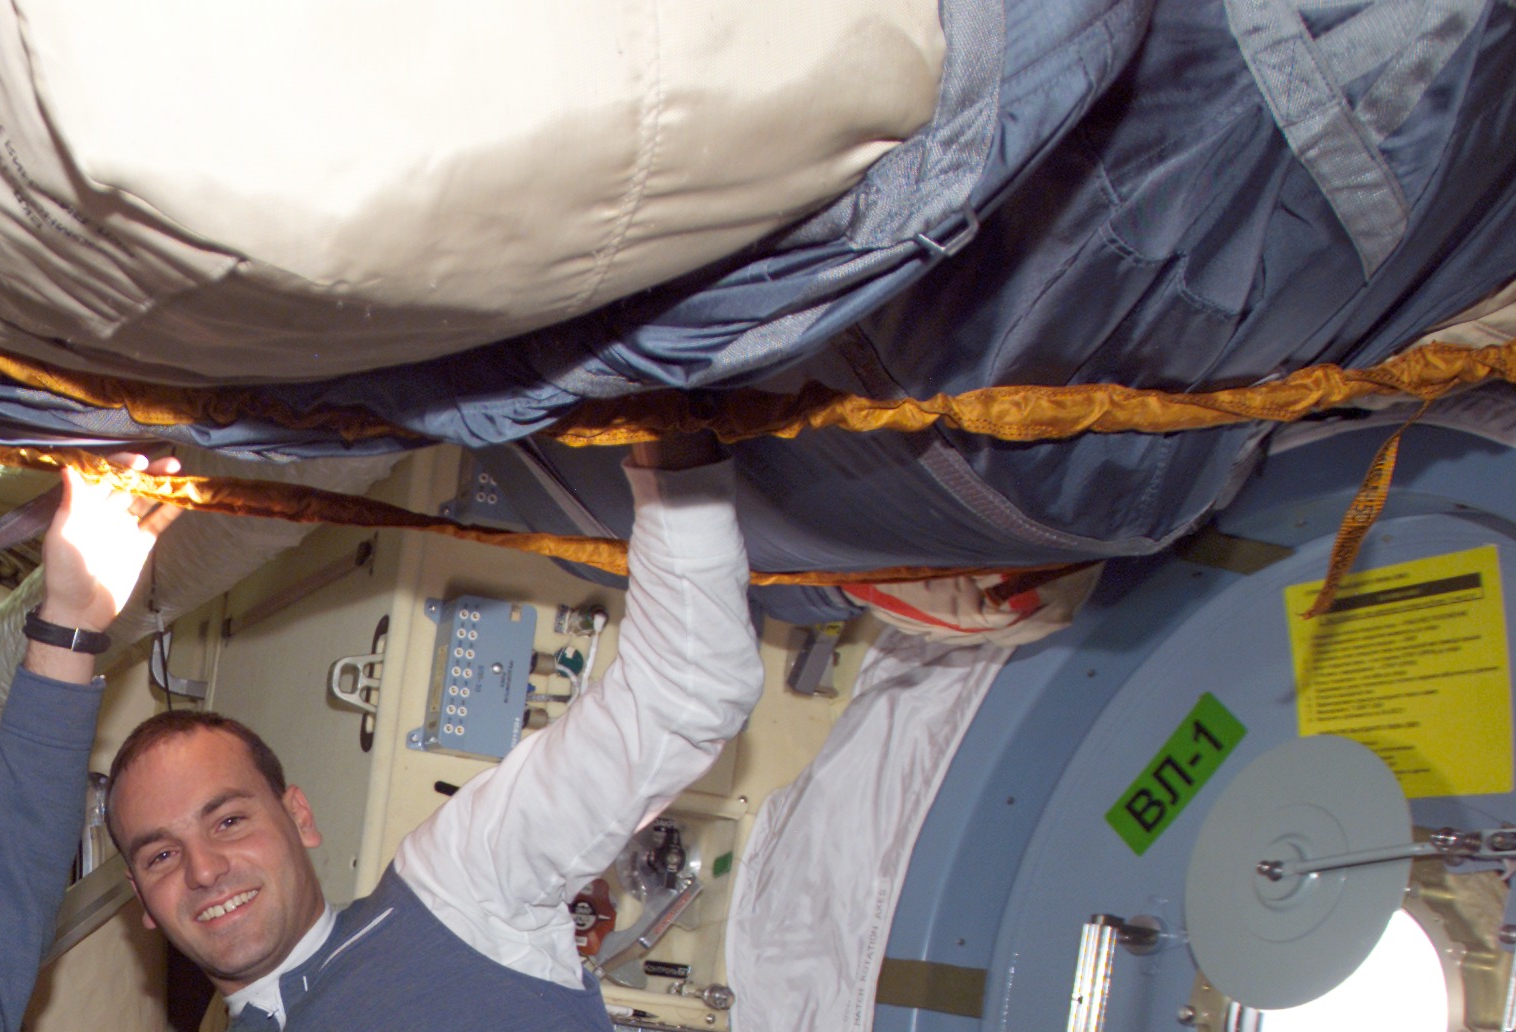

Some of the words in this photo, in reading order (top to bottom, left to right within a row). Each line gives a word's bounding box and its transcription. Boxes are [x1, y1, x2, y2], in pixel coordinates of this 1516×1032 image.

[1124, 719, 1224, 833] ВЛ-1
[853, 988, 864, 1027] HATCH
[859, 925, 879, 984] ROTATION
